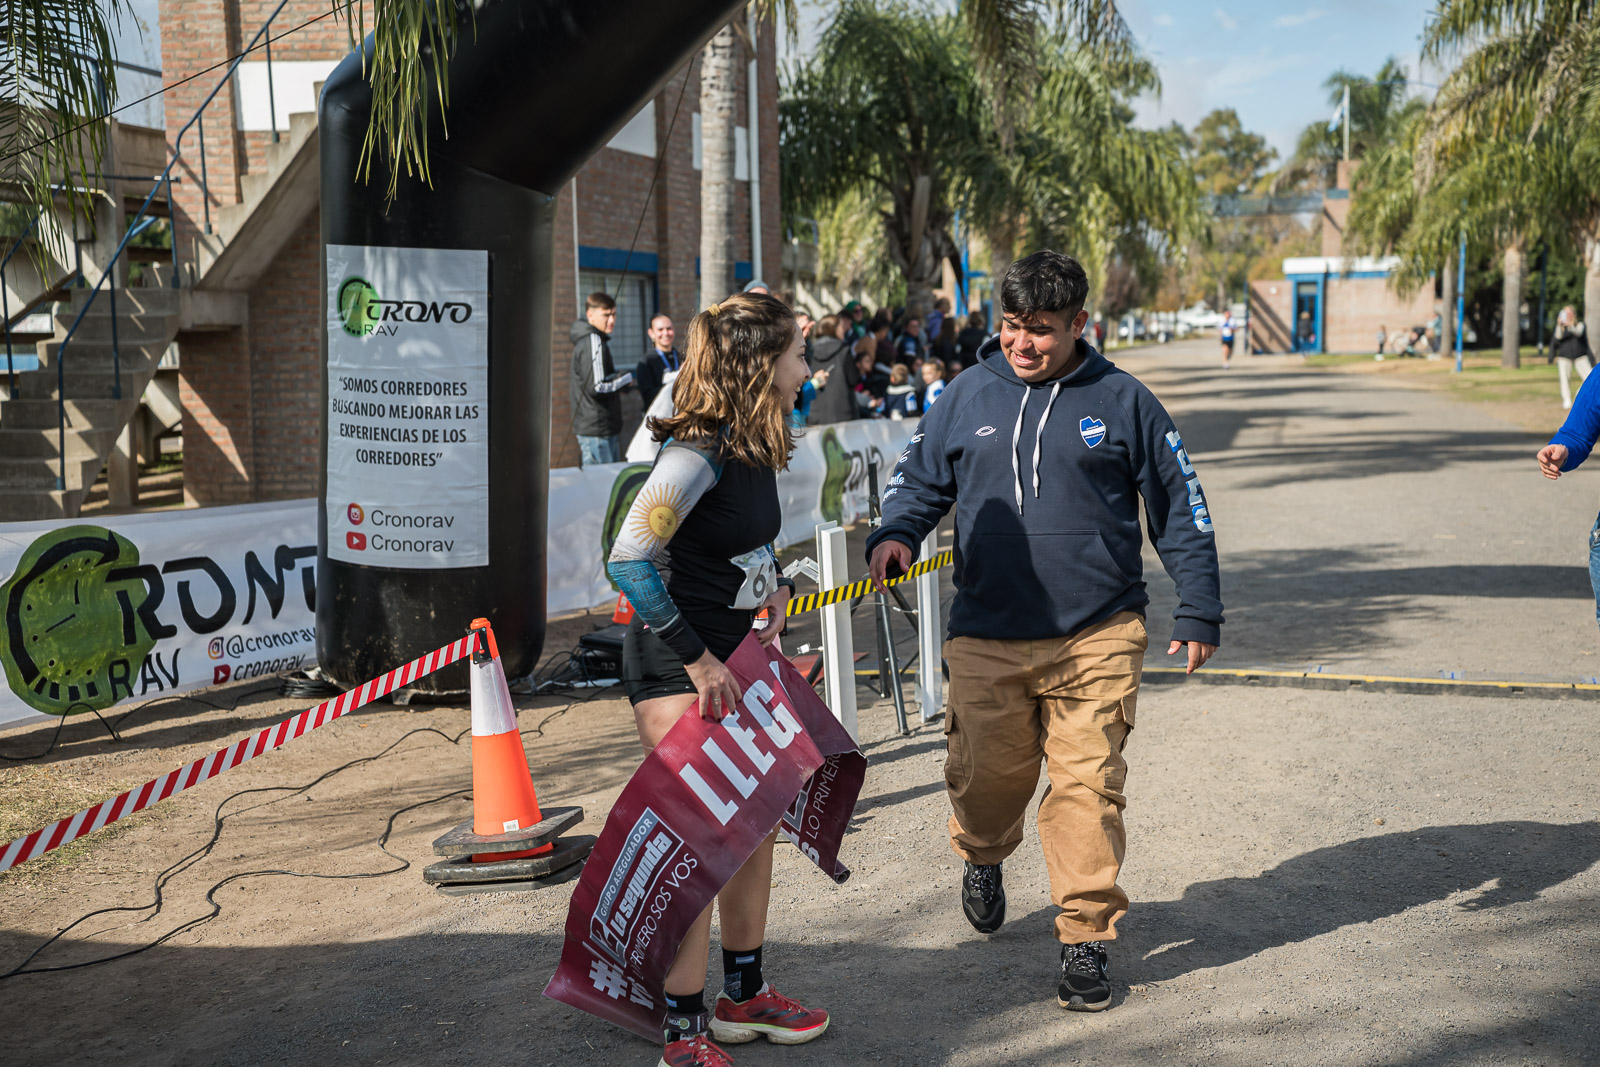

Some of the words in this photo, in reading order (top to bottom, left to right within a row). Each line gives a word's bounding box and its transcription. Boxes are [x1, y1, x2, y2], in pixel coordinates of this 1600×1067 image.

[366, 299, 472, 324] CRONO
[364, 324, 398, 336] RAV
[381, 380, 468, 397] CORREDORES
[332, 398, 386, 418] BUSCANDO
[389, 404, 451, 420] MEJORAR
[455, 405, 479, 420] LAS
[340, 422, 418, 443] EXPERIENCIAS
[422, 429, 439, 443] DE
[443, 429, 467, 443] LOS
[371, 510, 454, 528] Cronorav
[371, 534, 454, 552] Cronorav
[109, 648, 181, 701] RAV
[233, 654, 305, 680] cronorav
[806, 815, 820, 840] LO
[600, 885, 617, 917] GRUPO
[614, 818, 653, 887] ASEGURADOR
[630, 915, 657, 965] PRIMERO
[650, 886, 672, 920] SOS
[665, 852, 698, 888] VOS
